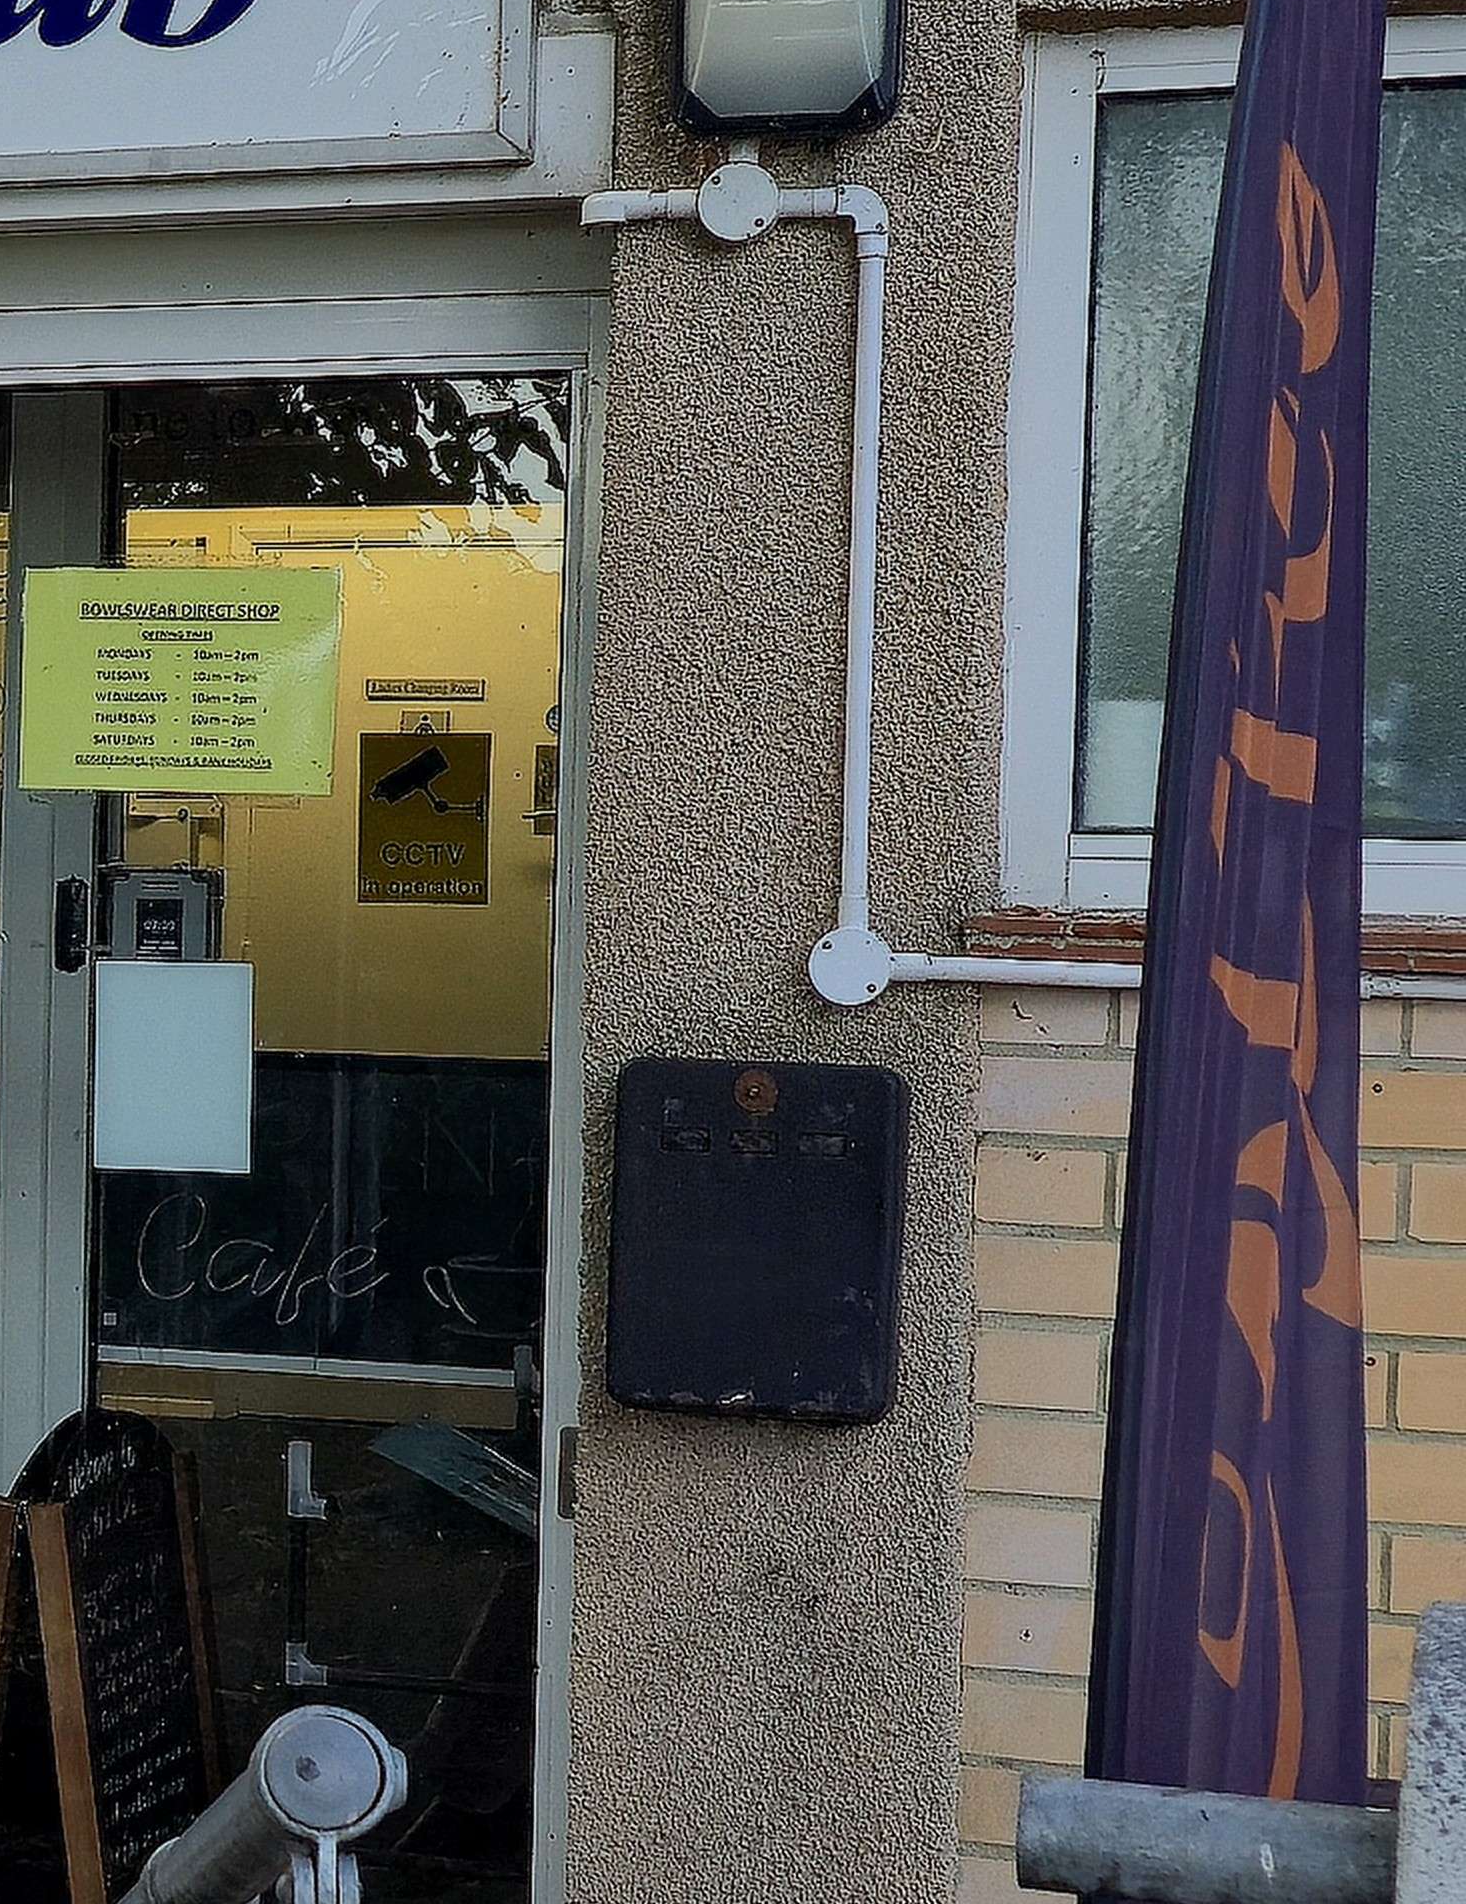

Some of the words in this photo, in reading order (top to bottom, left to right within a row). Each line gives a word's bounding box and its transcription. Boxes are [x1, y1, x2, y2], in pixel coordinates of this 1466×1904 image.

[80, 602, 177, 618] BOWLSWEAR
[180, 603, 235, 618] DIRECT
[237, 603, 280, 619] SHOP
[97, 648, 152, 660] MONDAYS
[234, 649, 259, 662] 2pm
[96, 671, 150, 682] TUESDAYS
[233, 672, 258, 684] 2pm
[95, 692, 167, 703] WEDNESDAYS
[232, 693, 257, 706] 2pm
[93, 713, 157, 725] THURSDAYS
[230, 715, 256, 728] 2pm
[93, 735, 155, 746] SATURDAYS
[230, 736, 255, 749] 2pm
[380, 842, 466, 866] CCTV
[387, 877, 484, 897] operation
[136, 1192, 392, 1326] Café
